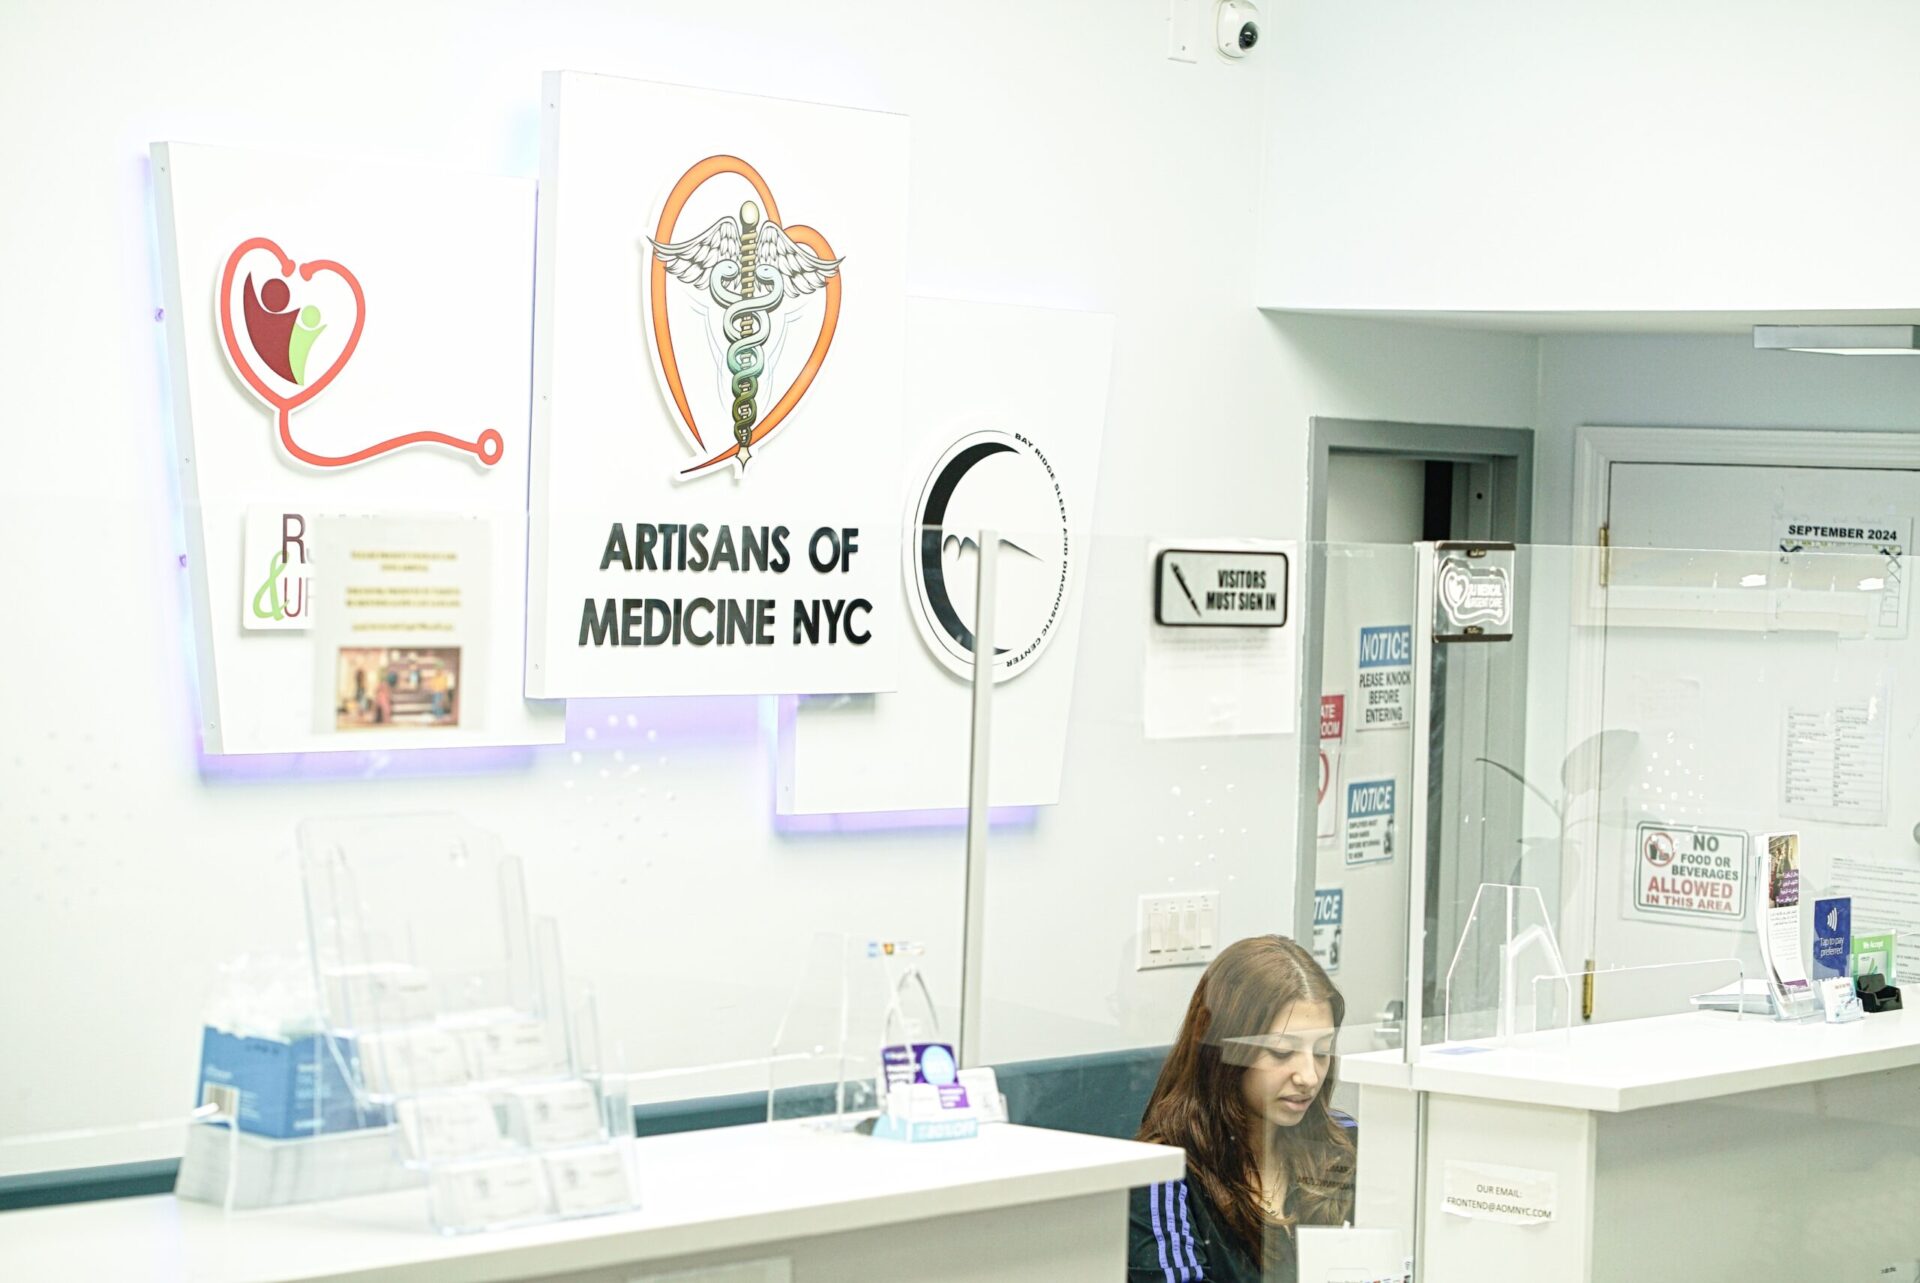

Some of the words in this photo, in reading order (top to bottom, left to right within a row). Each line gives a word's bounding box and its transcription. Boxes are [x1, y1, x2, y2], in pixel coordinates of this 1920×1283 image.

[1014, 432, 1034, 448] BAY
[1034, 447, 1056, 481] RIDGE
[1054, 483, 1067, 523] SLEEP
[282, 513, 315, 564] R
[1788, 524, 1864, 540] SEPTEMBER
[1867, 529, 1897, 541] 2024
[599, 522, 791, 573] ARTISANS
[808, 526, 859, 573] OF
[1218, 569, 1267, 589] VISITORS
[1041, 560, 1068, 637] DIAGNOSTIC
[1206, 591, 1236, 610] MUST
[1238, 591, 1263, 611] SIGN
[1265, 592, 1277, 611] IN
[578, 597, 776, 646] MEDICINE
[793, 597, 873, 646] NYC
[1006, 636, 1042, 668] CENTER
[1361, 631, 1410, 662] NOTICE
[1359, 672, 1384, 688] PLEASE
[1386, 670, 1412, 686] KNOCK
[1368, 689, 1400, 705] BEFORE
[1365, 707, 1403, 723] ENTERING
[1351, 785, 1393, 813] NOTICE
[1693, 834, 1719, 852] NO
[1681, 853, 1711, 865] FOOD
[1715, 856, 1731, 868] OR
[1671, 865, 1739, 881] BEVERAGES
[1648, 876, 1733, 899] ALLOWED
[1314, 894, 1340, 921] TICE
[1646, 894, 1660, 904] IN
[1663, 895, 1693, 907] THIS
[1697, 898, 1732, 911] AREA
[1820, 937, 1829, 947] Tap
[1835, 937, 1844, 946] pay
[1820, 947, 1843, 958] preferred
[1476, 1184, 1494, 1195] OUR
[1495, 1186, 1523, 1198] EMAIL:
[1447, 1196, 1552, 1218] FRONTEND@AOMNYC.COM
